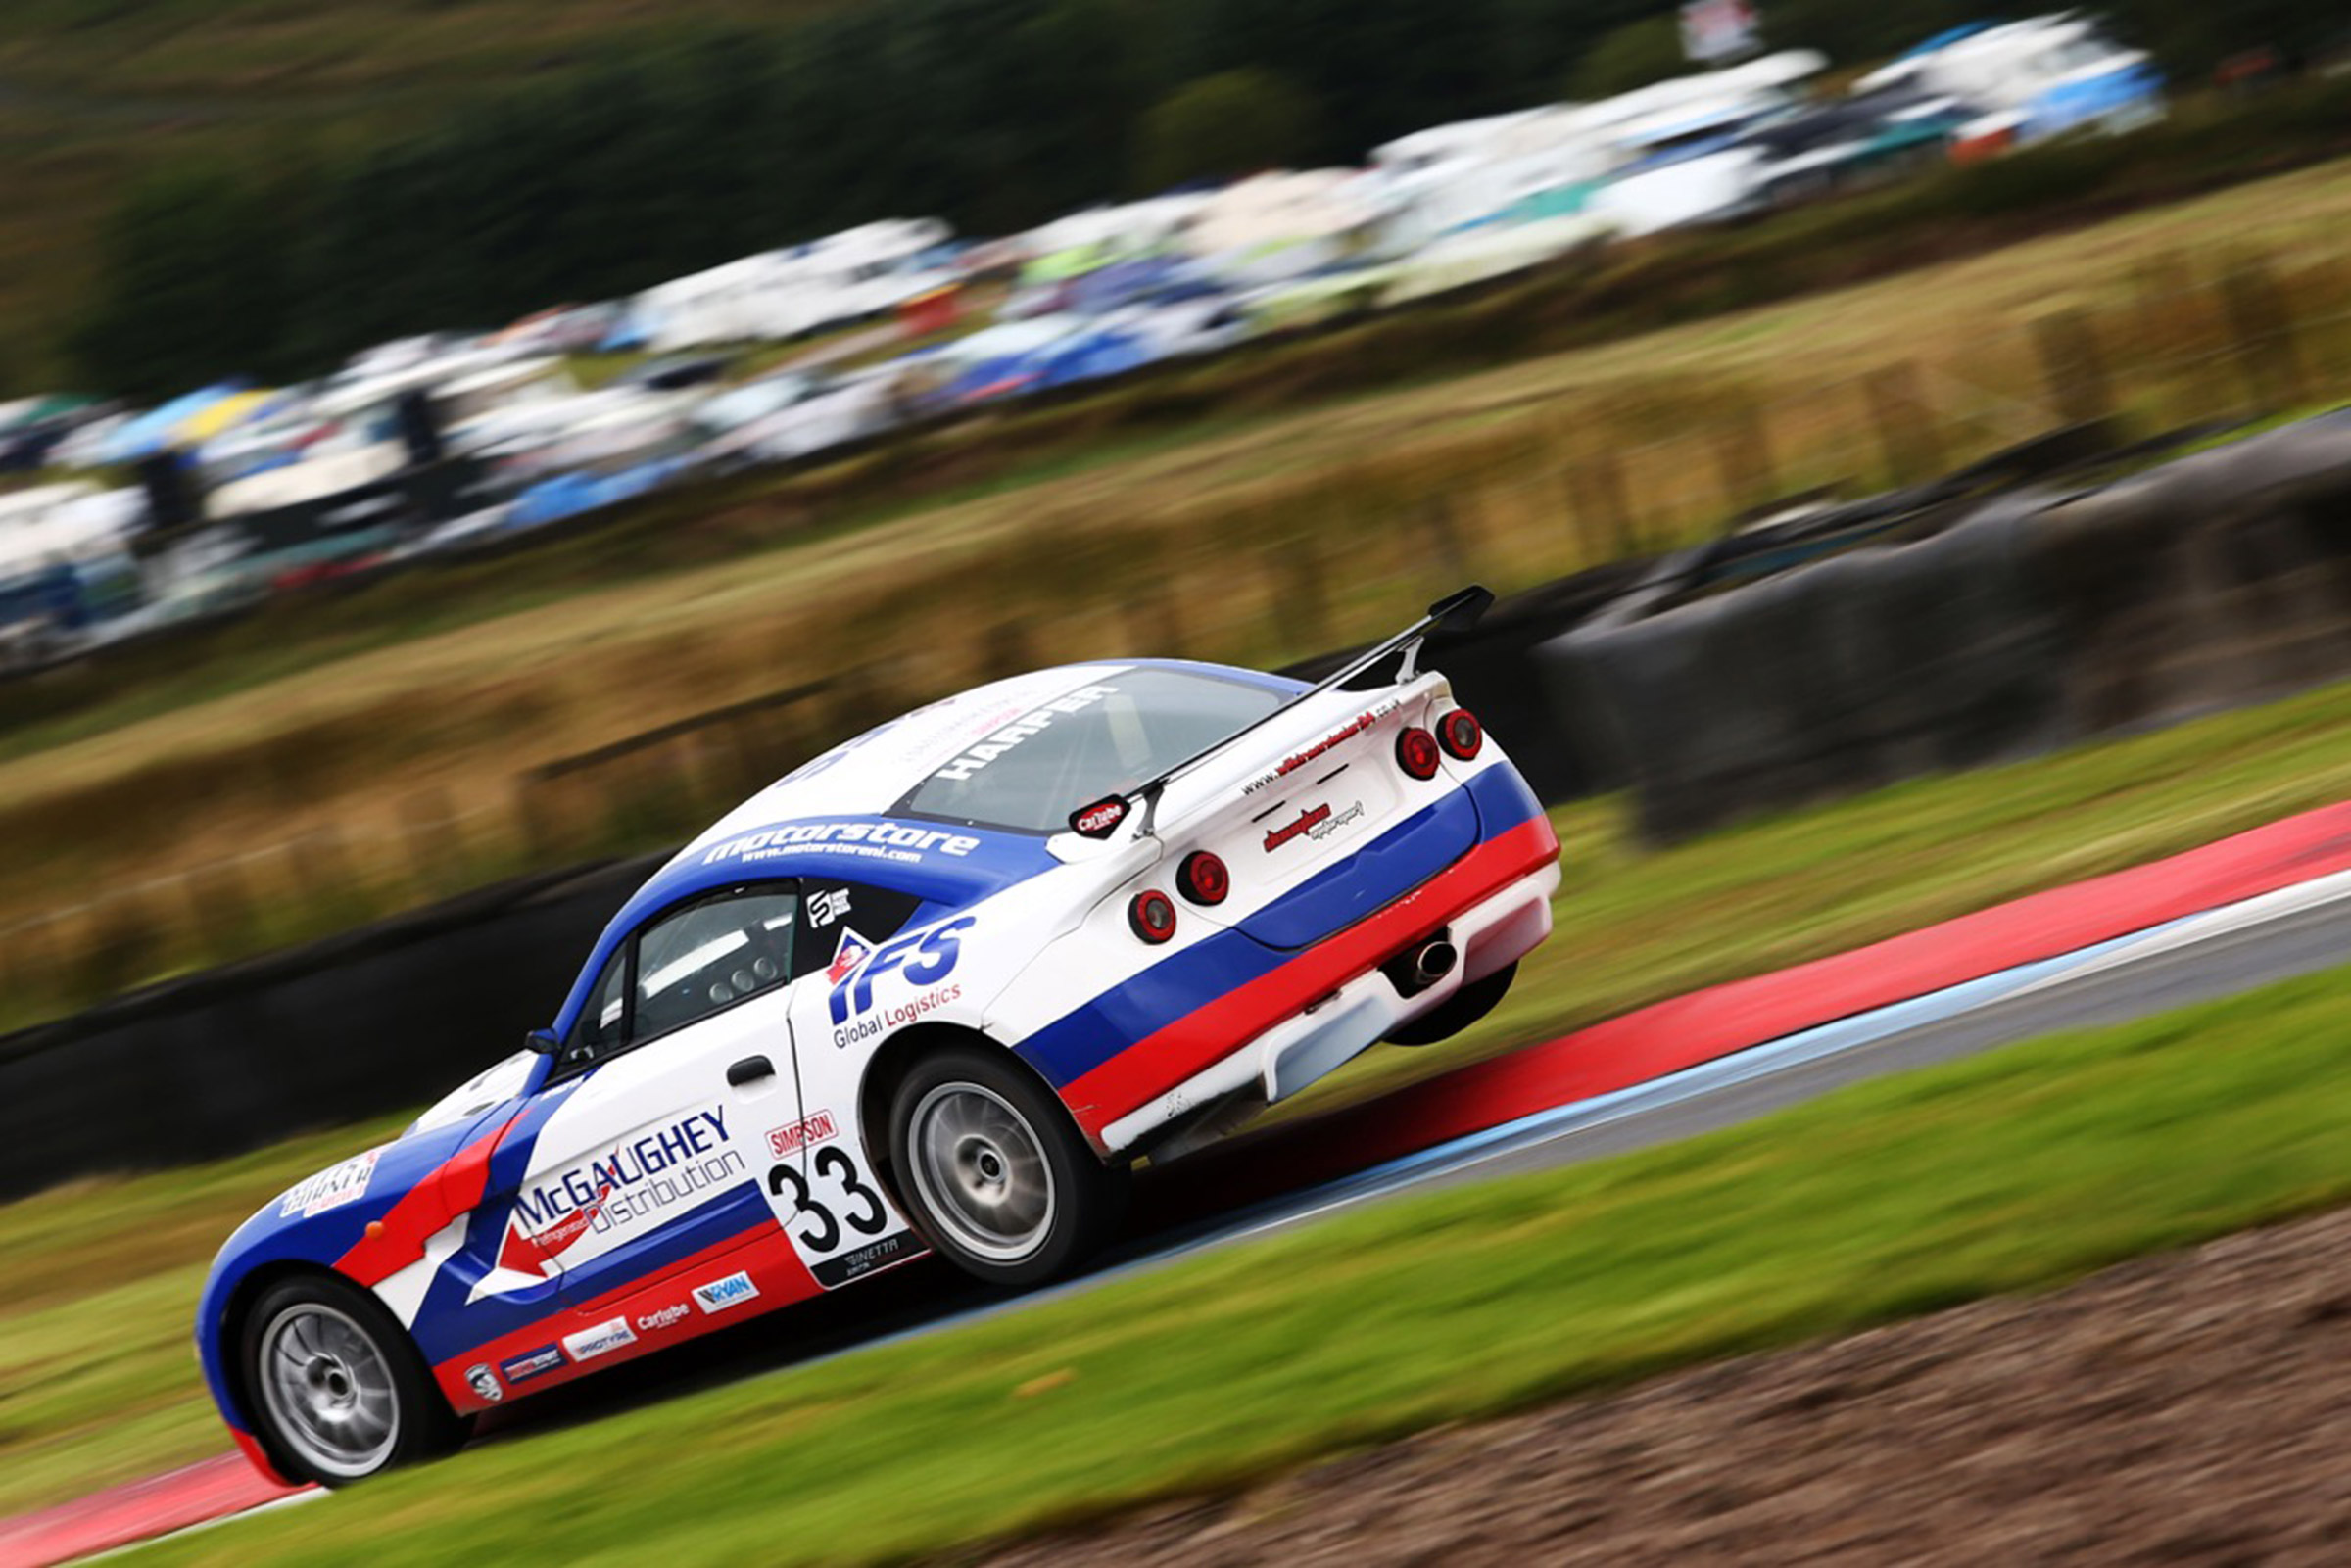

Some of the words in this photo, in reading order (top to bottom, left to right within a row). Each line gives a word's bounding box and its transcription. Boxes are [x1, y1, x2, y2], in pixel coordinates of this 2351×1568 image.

[701, 821, 981, 866] motorstore
[834, 1015, 884, 1050] Global
[885, 983, 962, 1028] Logistics
[513, 1105, 730, 1229] McGAUGHEY
[771, 1114, 833, 1155] SIMPSON
[584, 1148, 745, 1235] Distribution
[768, 1145, 888, 1254] 33
[844, 1238, 899, 1265] GINETTA
